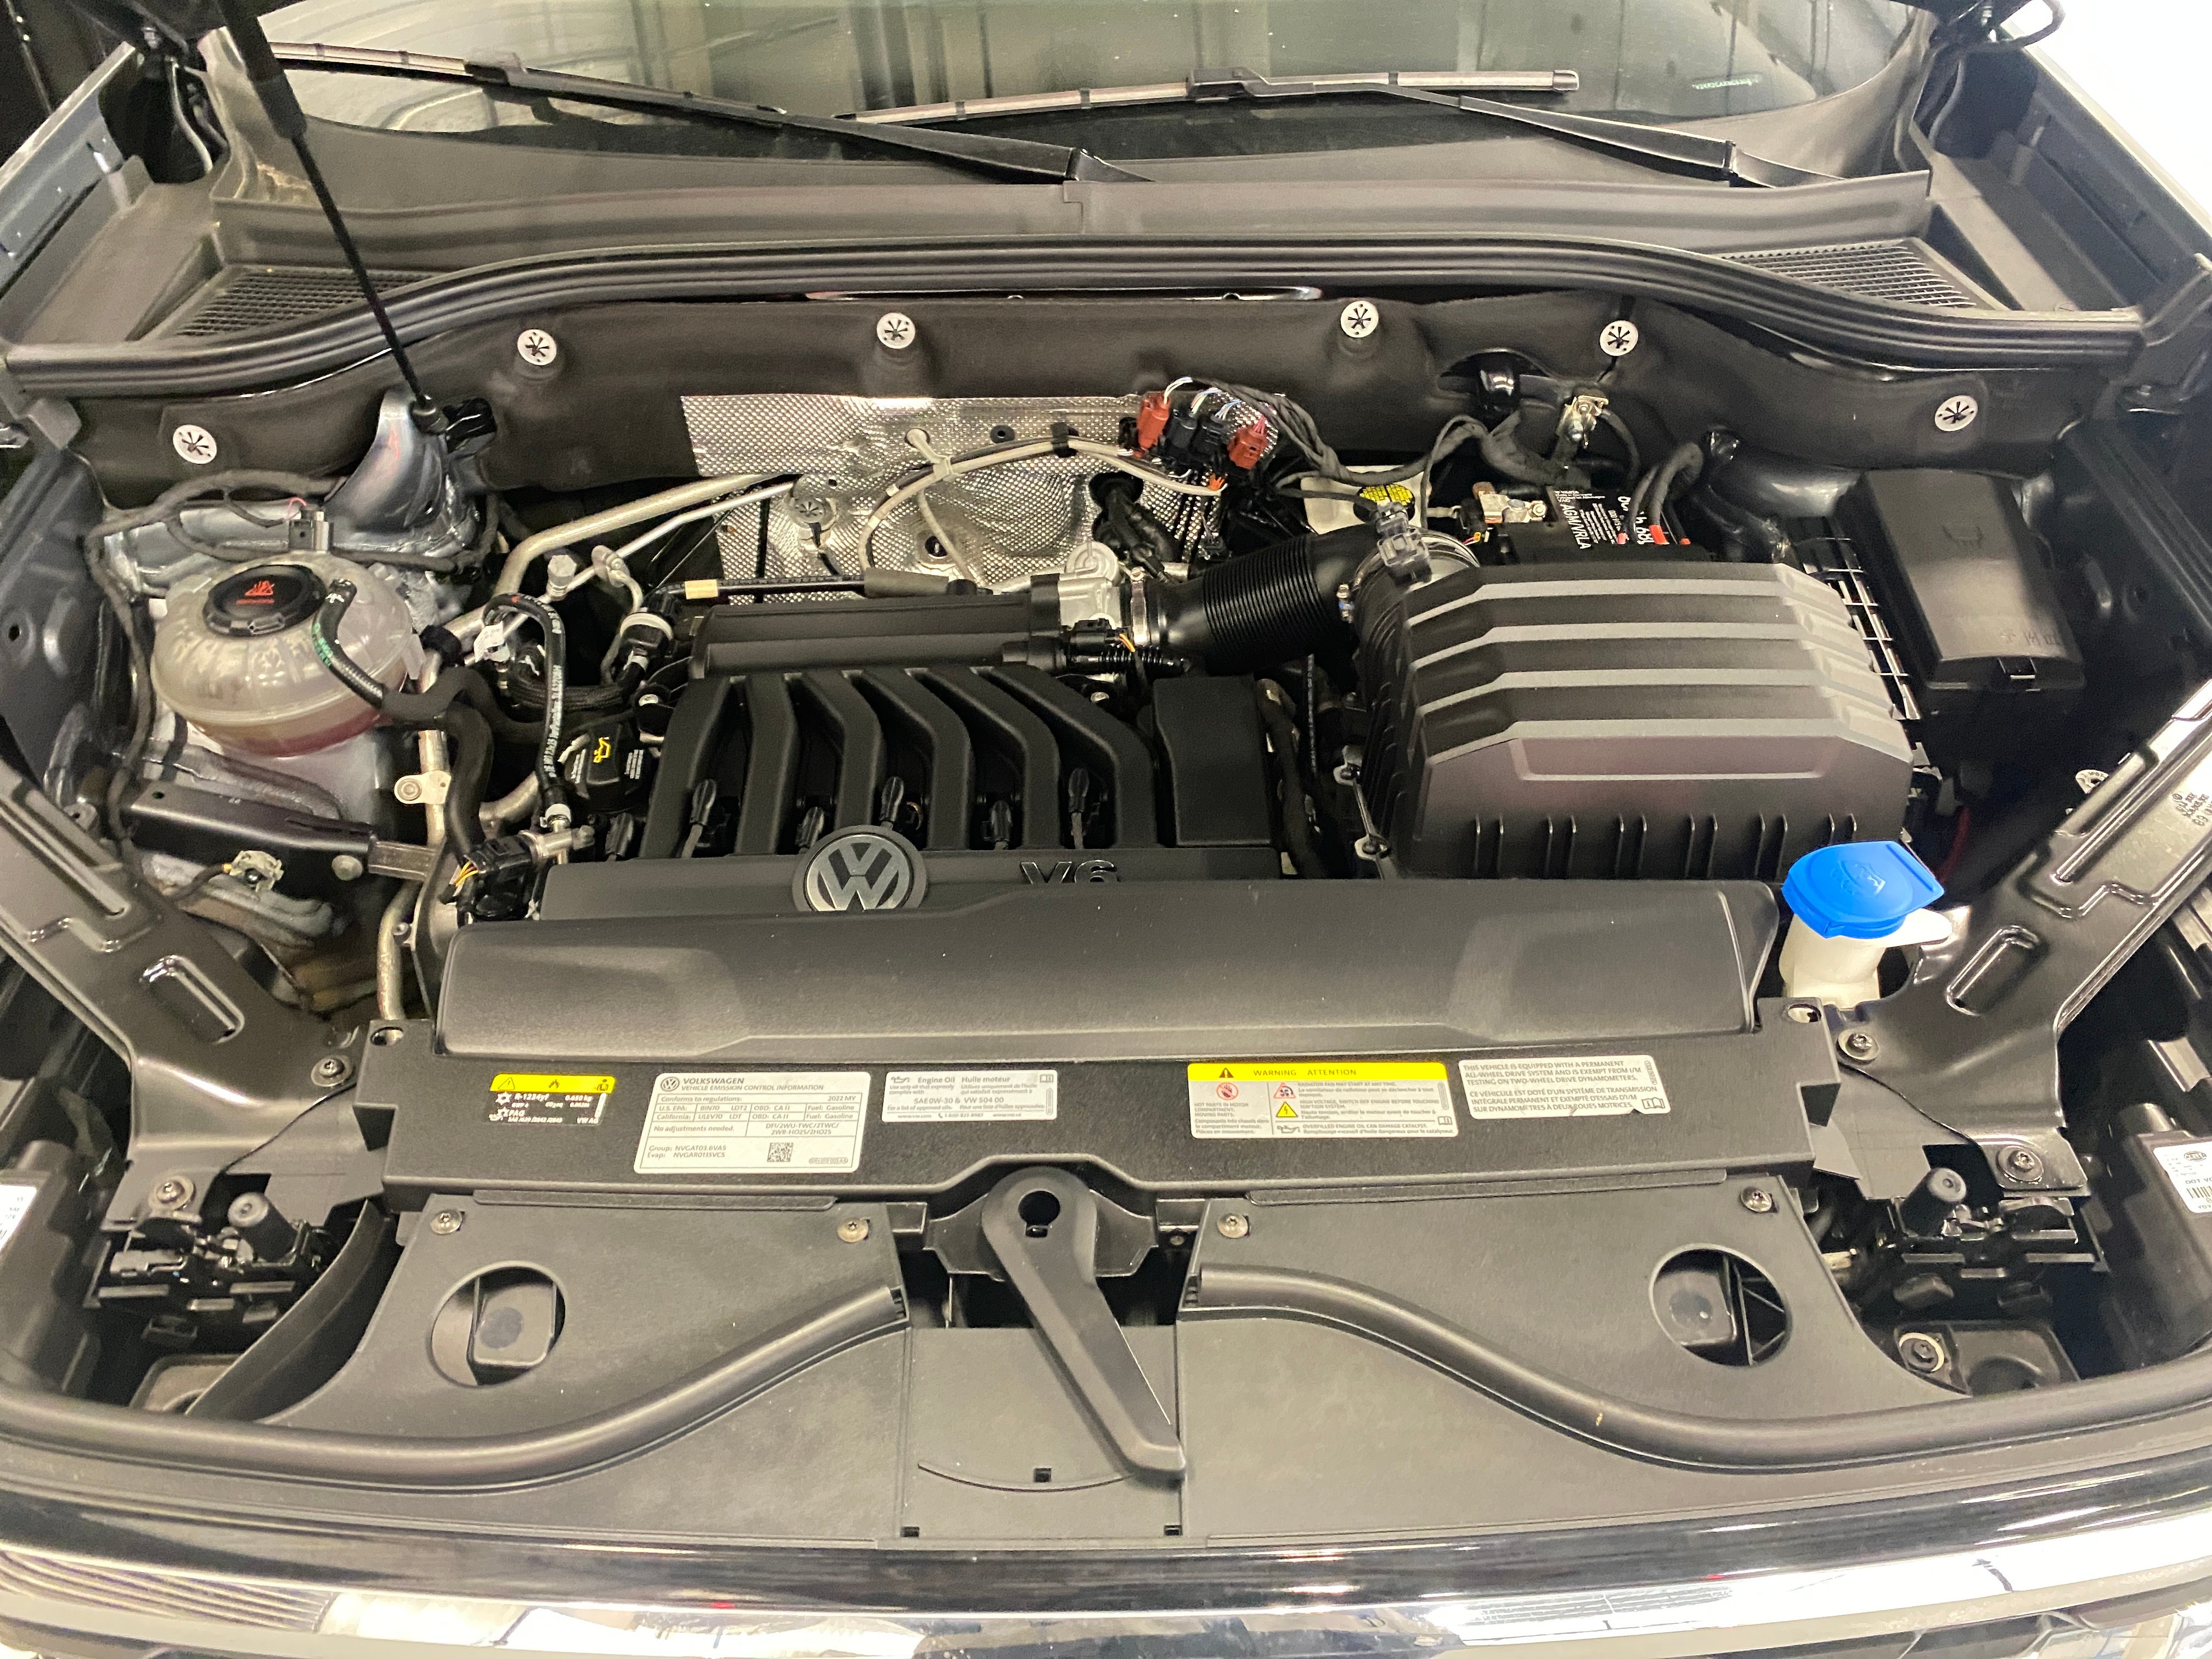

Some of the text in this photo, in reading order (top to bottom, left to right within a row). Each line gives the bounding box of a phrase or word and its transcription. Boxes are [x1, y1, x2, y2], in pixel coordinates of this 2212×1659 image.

[1560, 504, 1592, 549] AGM/VRLA
[1020, 859, 1119, 884] V6
[918, 1077, 943, 1085] Engine
